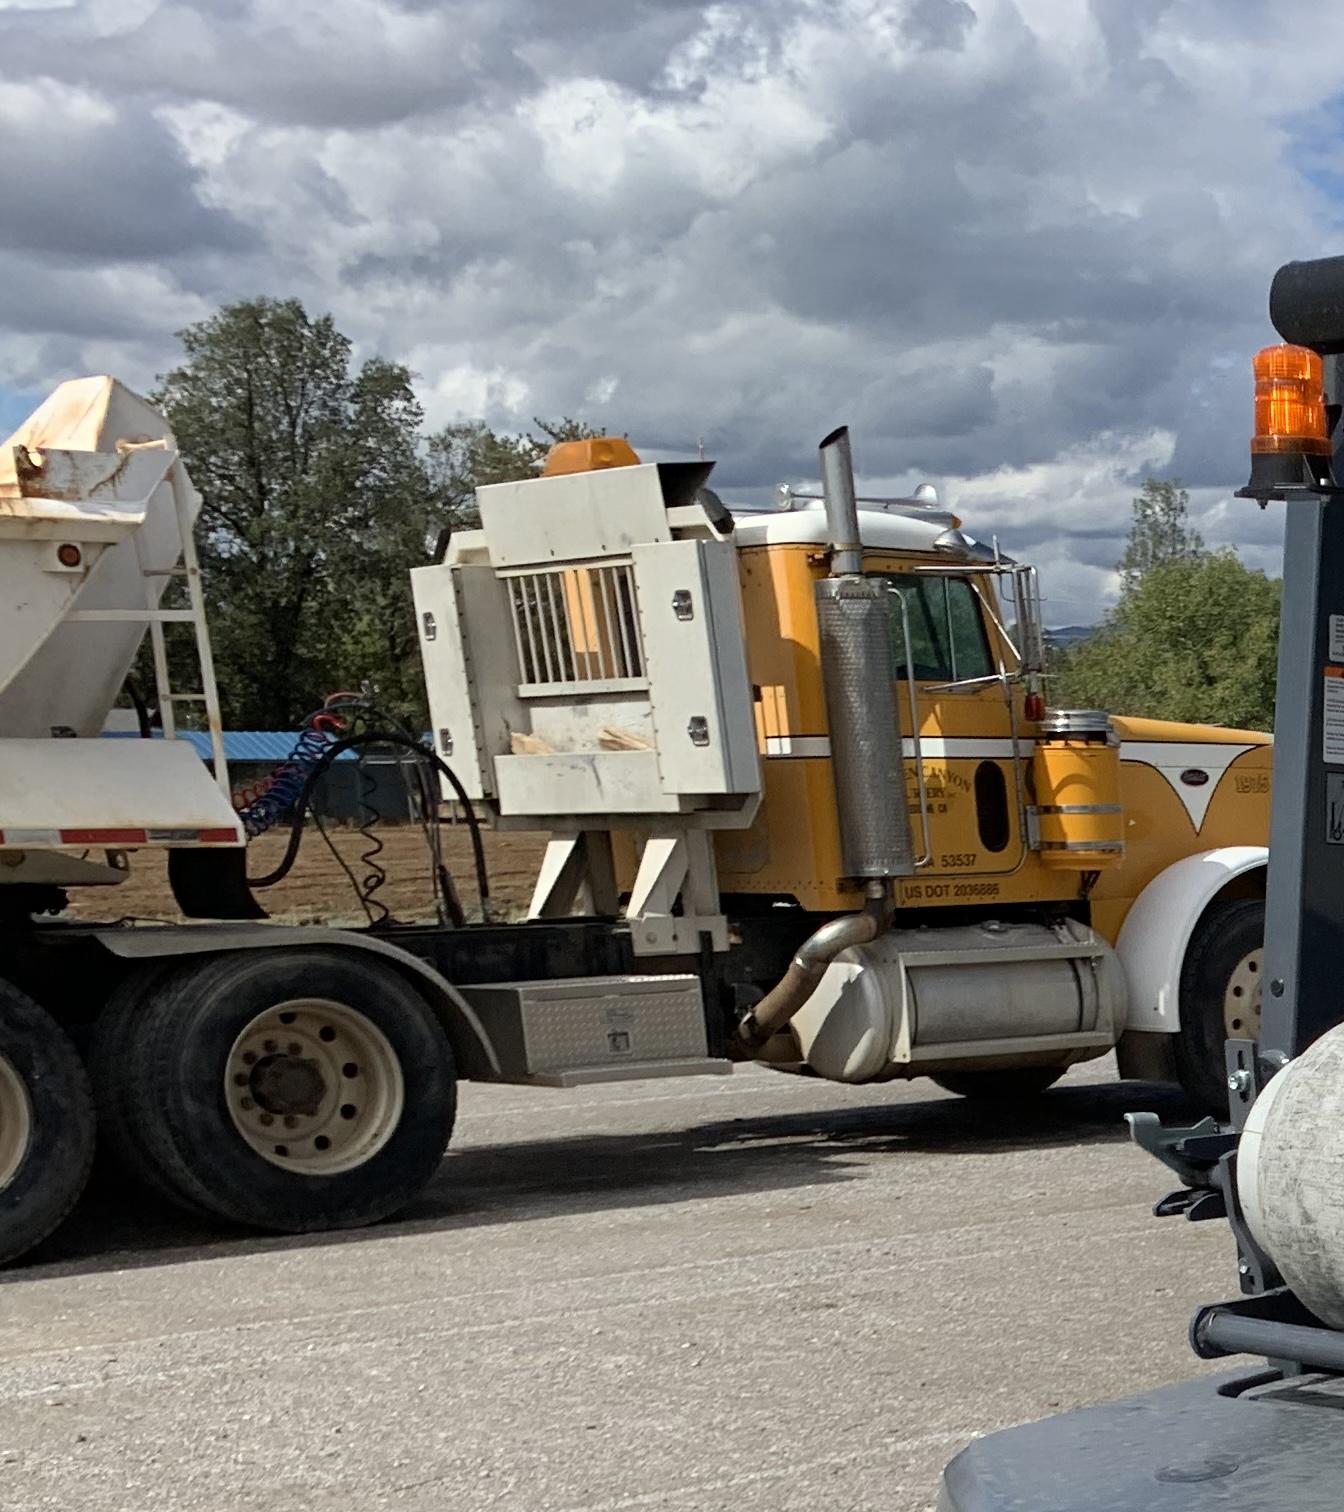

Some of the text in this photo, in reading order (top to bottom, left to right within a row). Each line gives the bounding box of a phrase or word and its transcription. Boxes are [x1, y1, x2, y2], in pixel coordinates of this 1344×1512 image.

[941, 854, 977, 868] 53537
[904, 886, 922, 899] US
[925, 885, 950, 898] DOT
